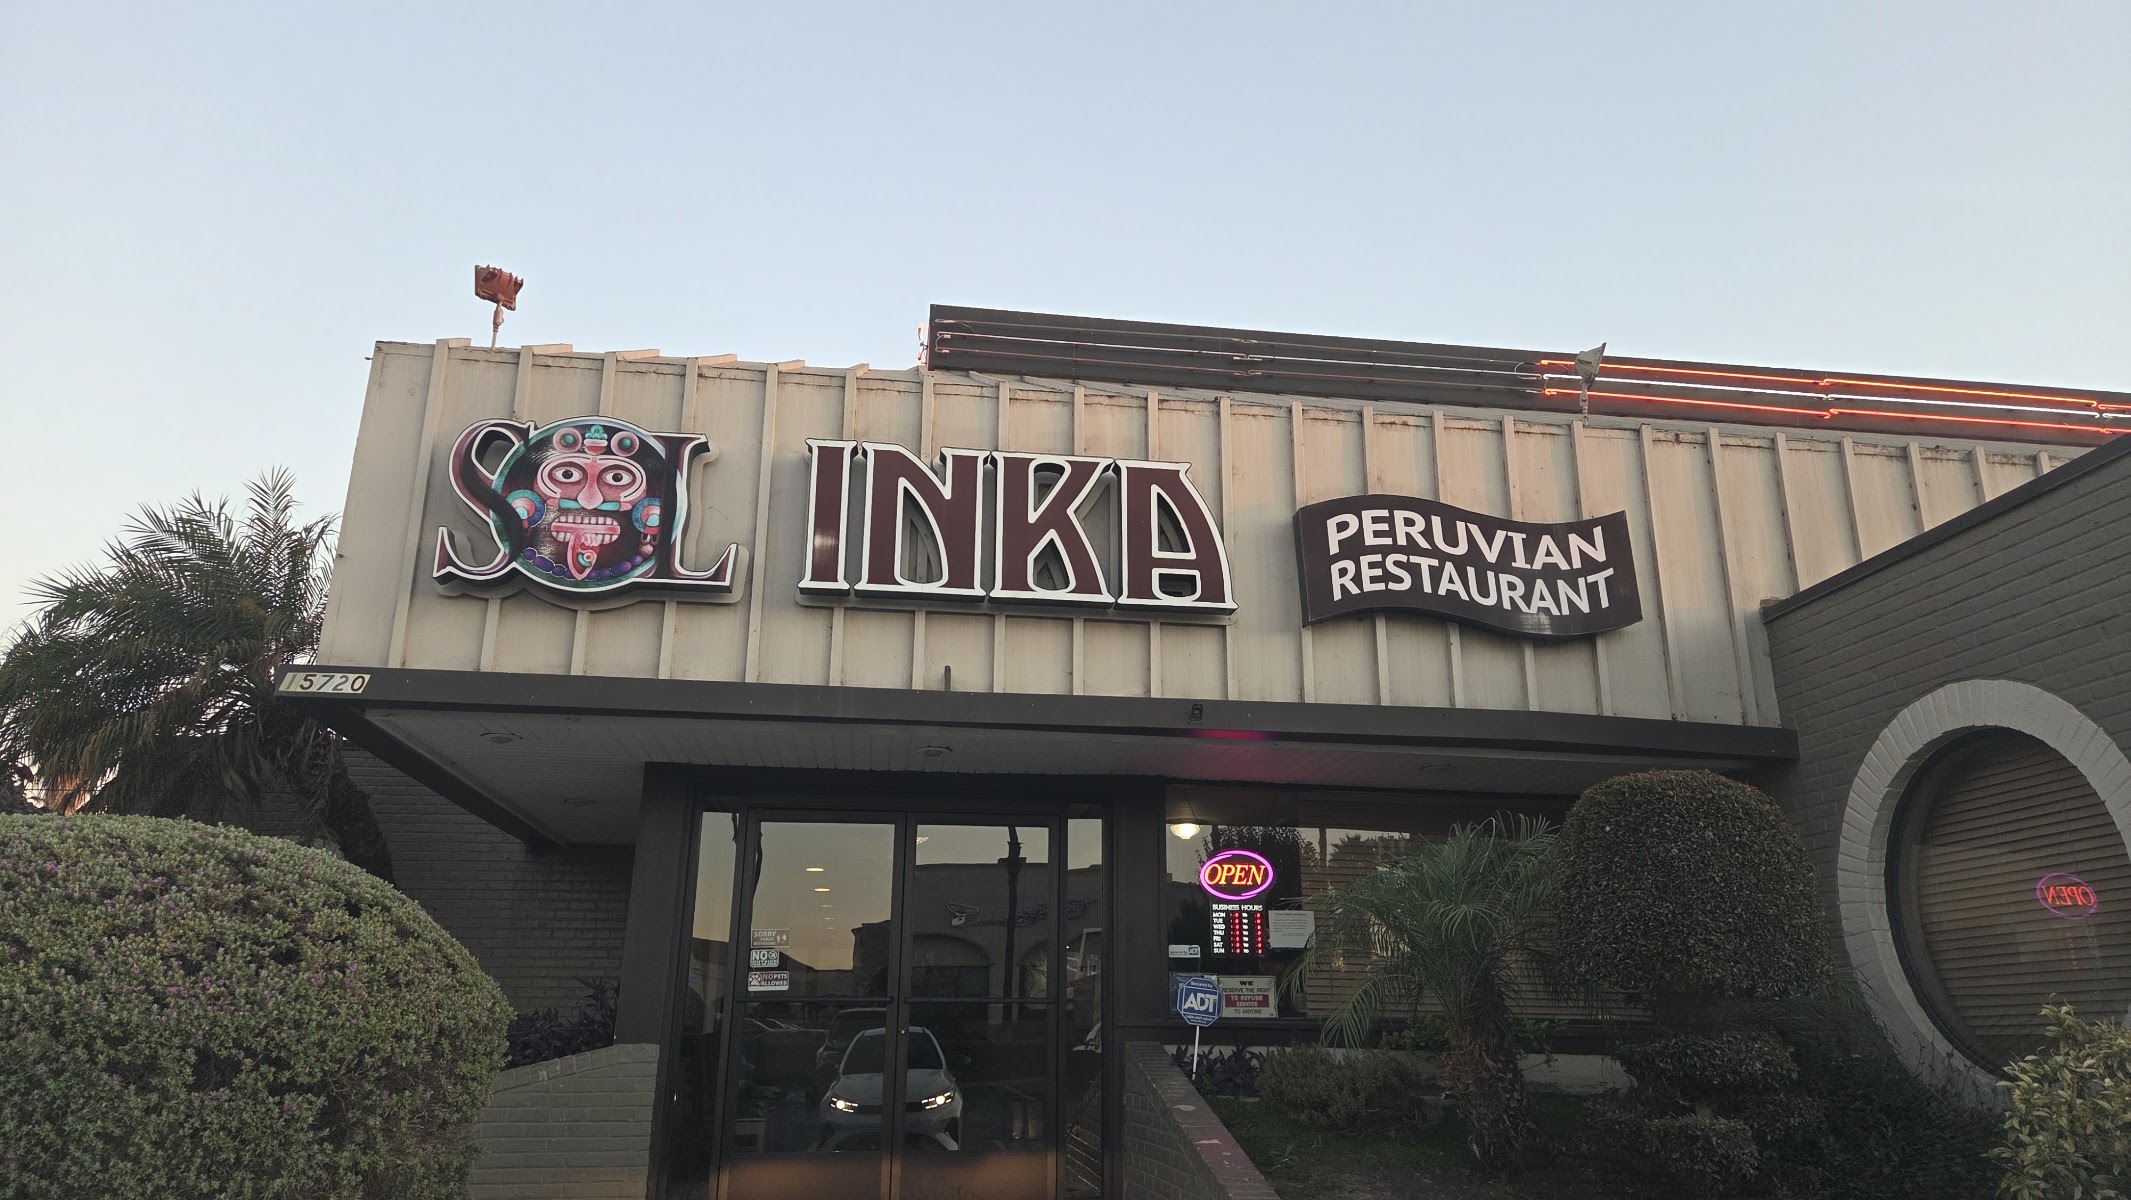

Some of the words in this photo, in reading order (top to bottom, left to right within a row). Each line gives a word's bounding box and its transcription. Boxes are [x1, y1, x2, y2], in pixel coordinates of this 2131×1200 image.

[798, 438, 1239, 614] INKA
[1327, 509, 1606, 570] PERUVIAN
[1330, 553, 1615, 616] RESTAURANT
[285, 674, 366, 692] 15720
[1205, 864, 1266, 885] OPEN
[753, 951, 768, 960] NO
[1183, 992, 1217, 1013] ADT
